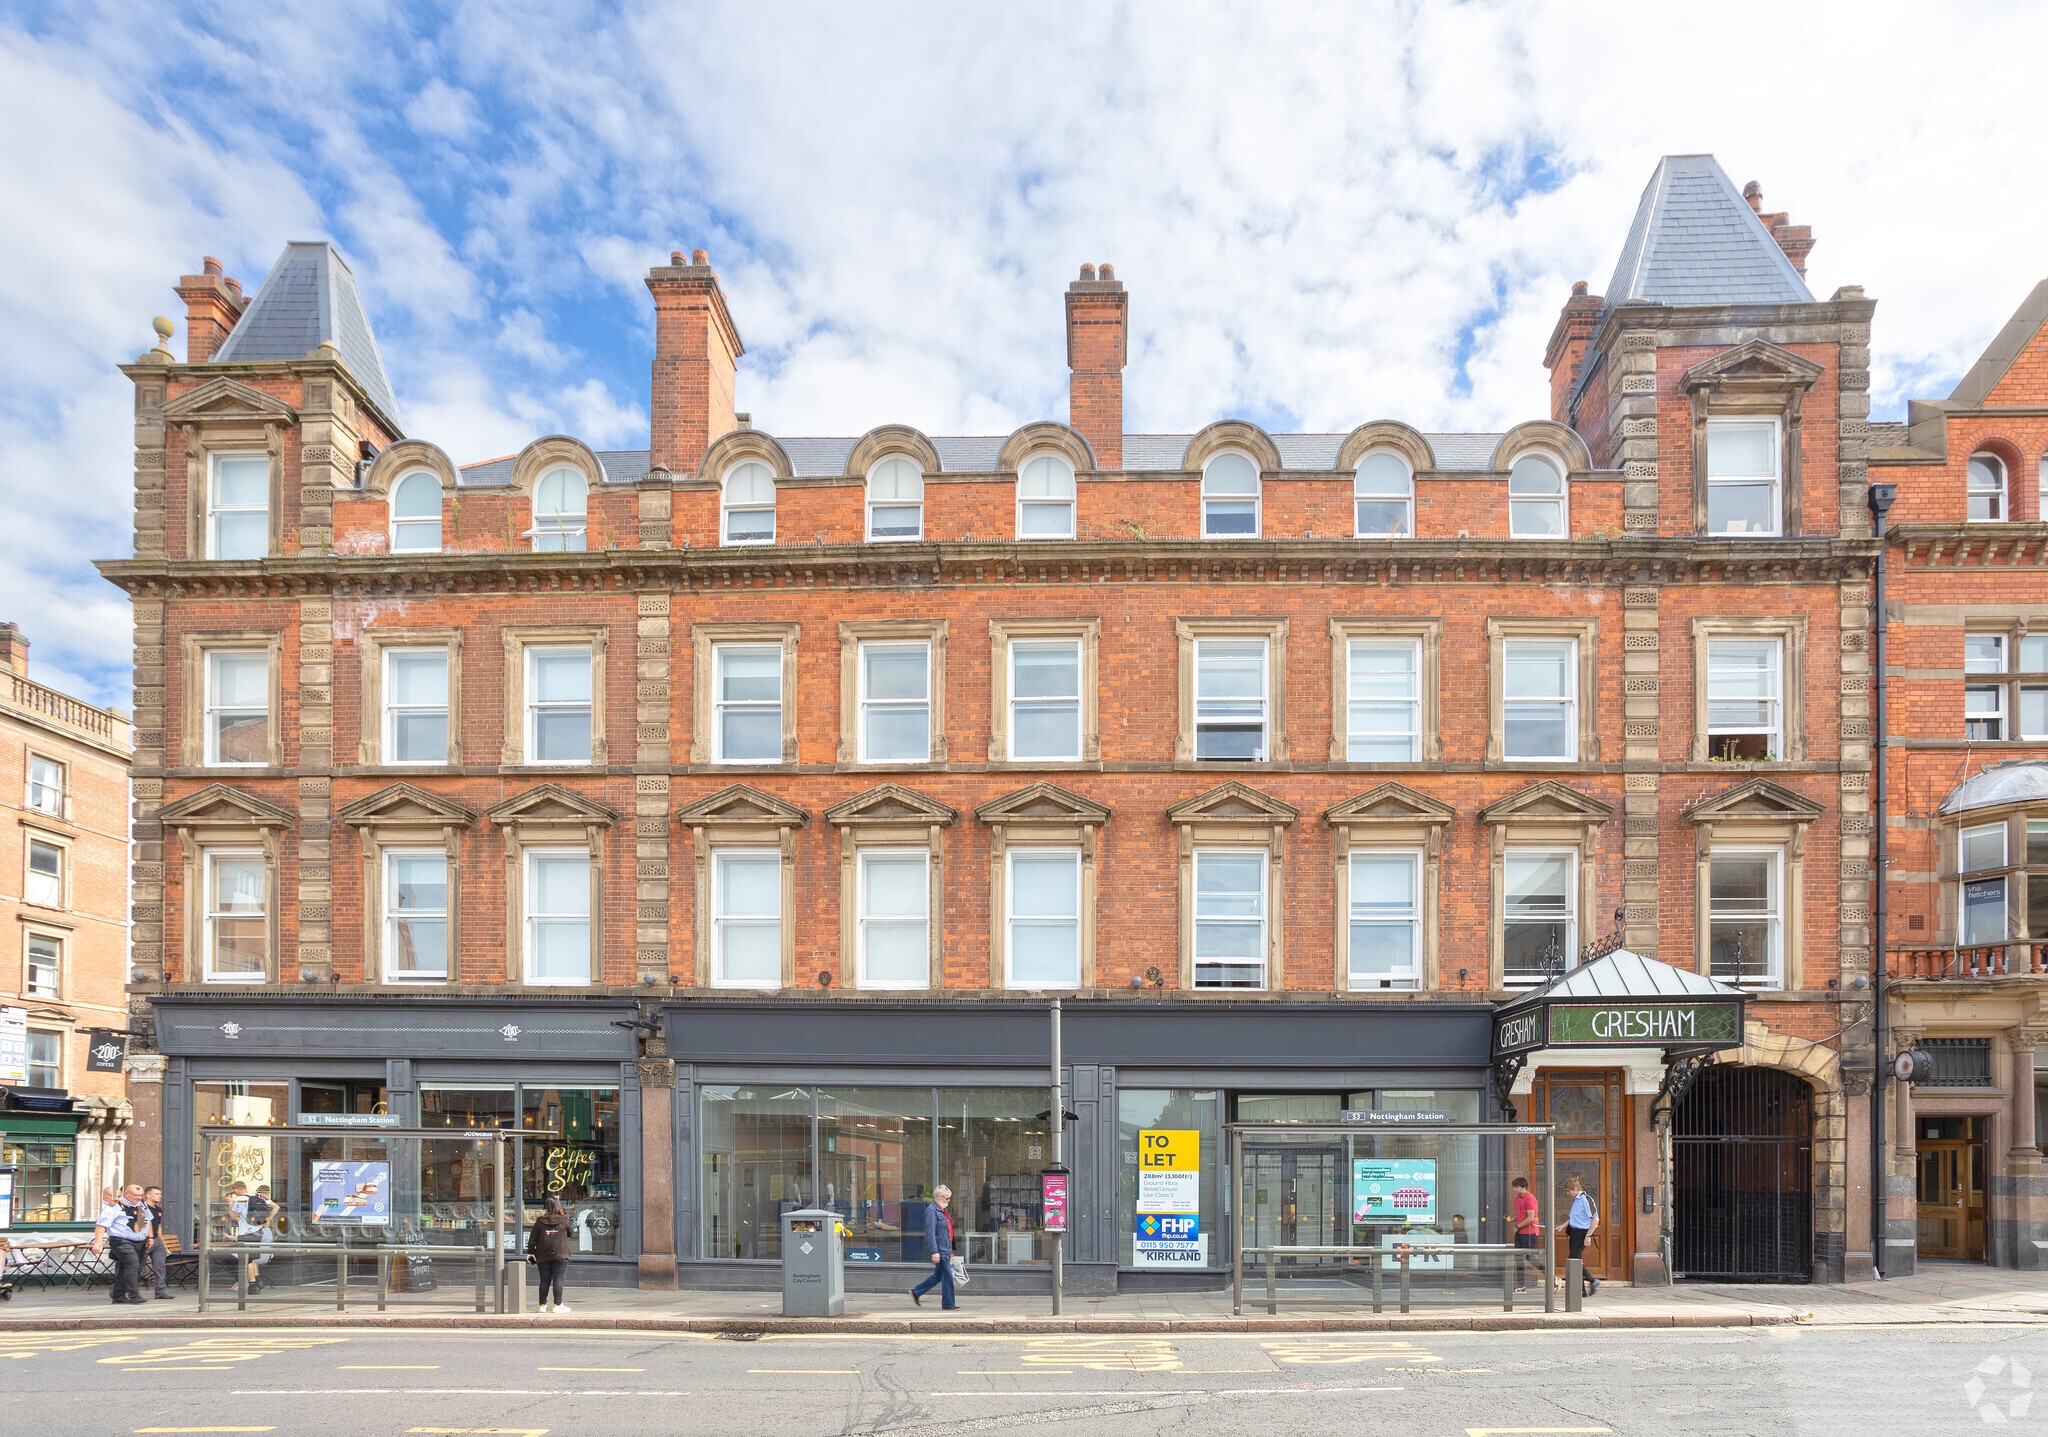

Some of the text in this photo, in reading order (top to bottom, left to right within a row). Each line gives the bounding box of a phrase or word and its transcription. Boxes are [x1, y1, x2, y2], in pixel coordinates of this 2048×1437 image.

[1968, 890, 2001, 899] fletchers
[1591, 1009, 1696, 1038] GRESHAM
[1500, 1014, 1536, 1048] GRESHAM
[324, 1116, 367, 1125] Nottingham
[368, 1116, 395, 1124] Station
[1370, 1113, 1415, 1121] Nottingham
[1144, 1135, 1170, 1148] TO
[545, 1146, 596, 1171] Coffee
[1144, 1153, 1176, 1166] LET
[547, 1168, 592, 1192] Shop
[1161, 1218, 1195, 1233] FHP
[1146, 1251, 1201, 1261] KIRKLAND
